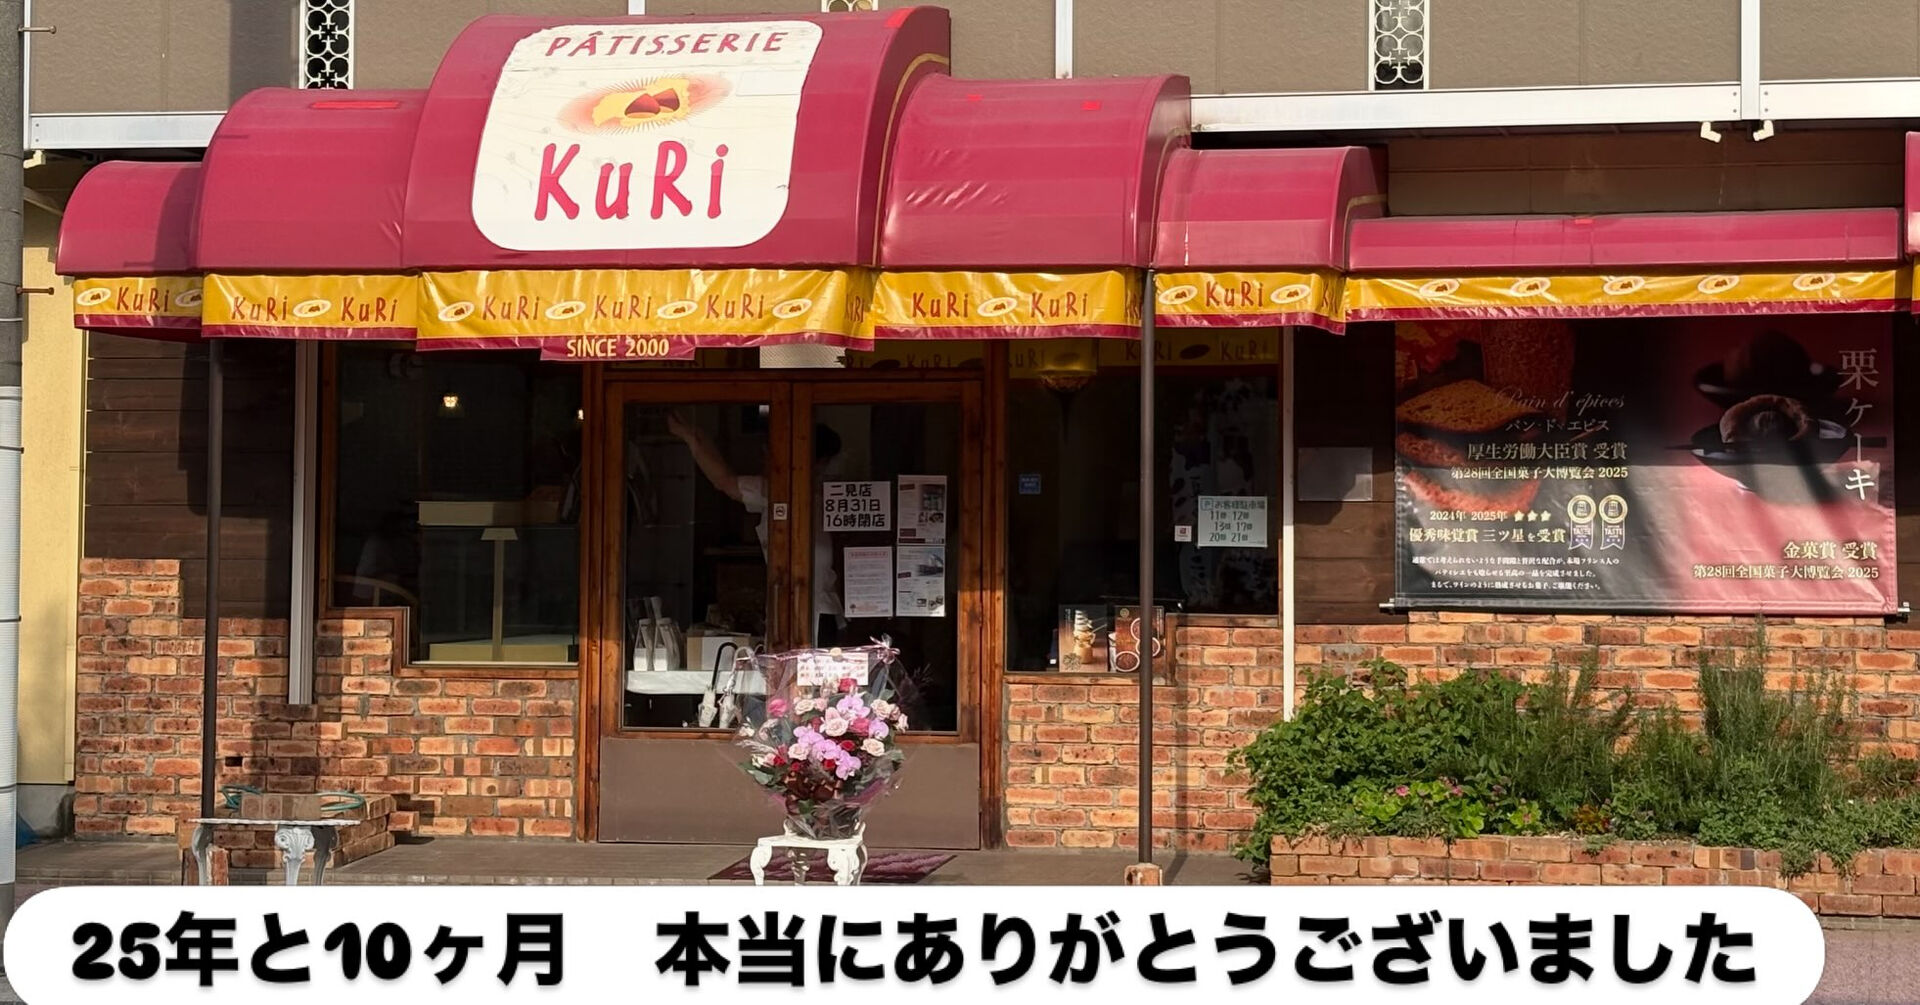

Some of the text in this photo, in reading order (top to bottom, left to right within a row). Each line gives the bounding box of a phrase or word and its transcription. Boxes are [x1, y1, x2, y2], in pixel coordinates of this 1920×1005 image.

[546, 31, 788, 57] PÂTISSERIE
[534, 140, 729, 221] KuRi
[116, 286, 171, 313] KuRi
[912, 290, 1089, 318] KuRi KuRi
[1206, 280, 1264, 308] KuRi
[231, 295, 397, 322] KuRi KuRi
[482, 294, 540, 320] KuRi
[594, 295, 651, 320] KuRi
[706, 293, 765, 320] KuRi
[566, 335, 670, 358] SINCE 2000
[1838, 347, 1880, 500] 栗ケーキ
[1467, 442, 1628, 460] 厚生労働大臣賞 受賞
[1451, 466, 1629, 480] 第28回全国菓子大博覧会 2025
[830, 483, 873, 497] 二見店
[825, 499, 881, 512] 8月31日
[826, 514, 886, 528] 16時閉店
[1409, 528, 1480, 544] 優秀味覚賞
[1783, 541, 1878, 560] 金菓賞 受賞
[1693, 565, 1879, 579] 第28回全国菓子大博覧会 2025
